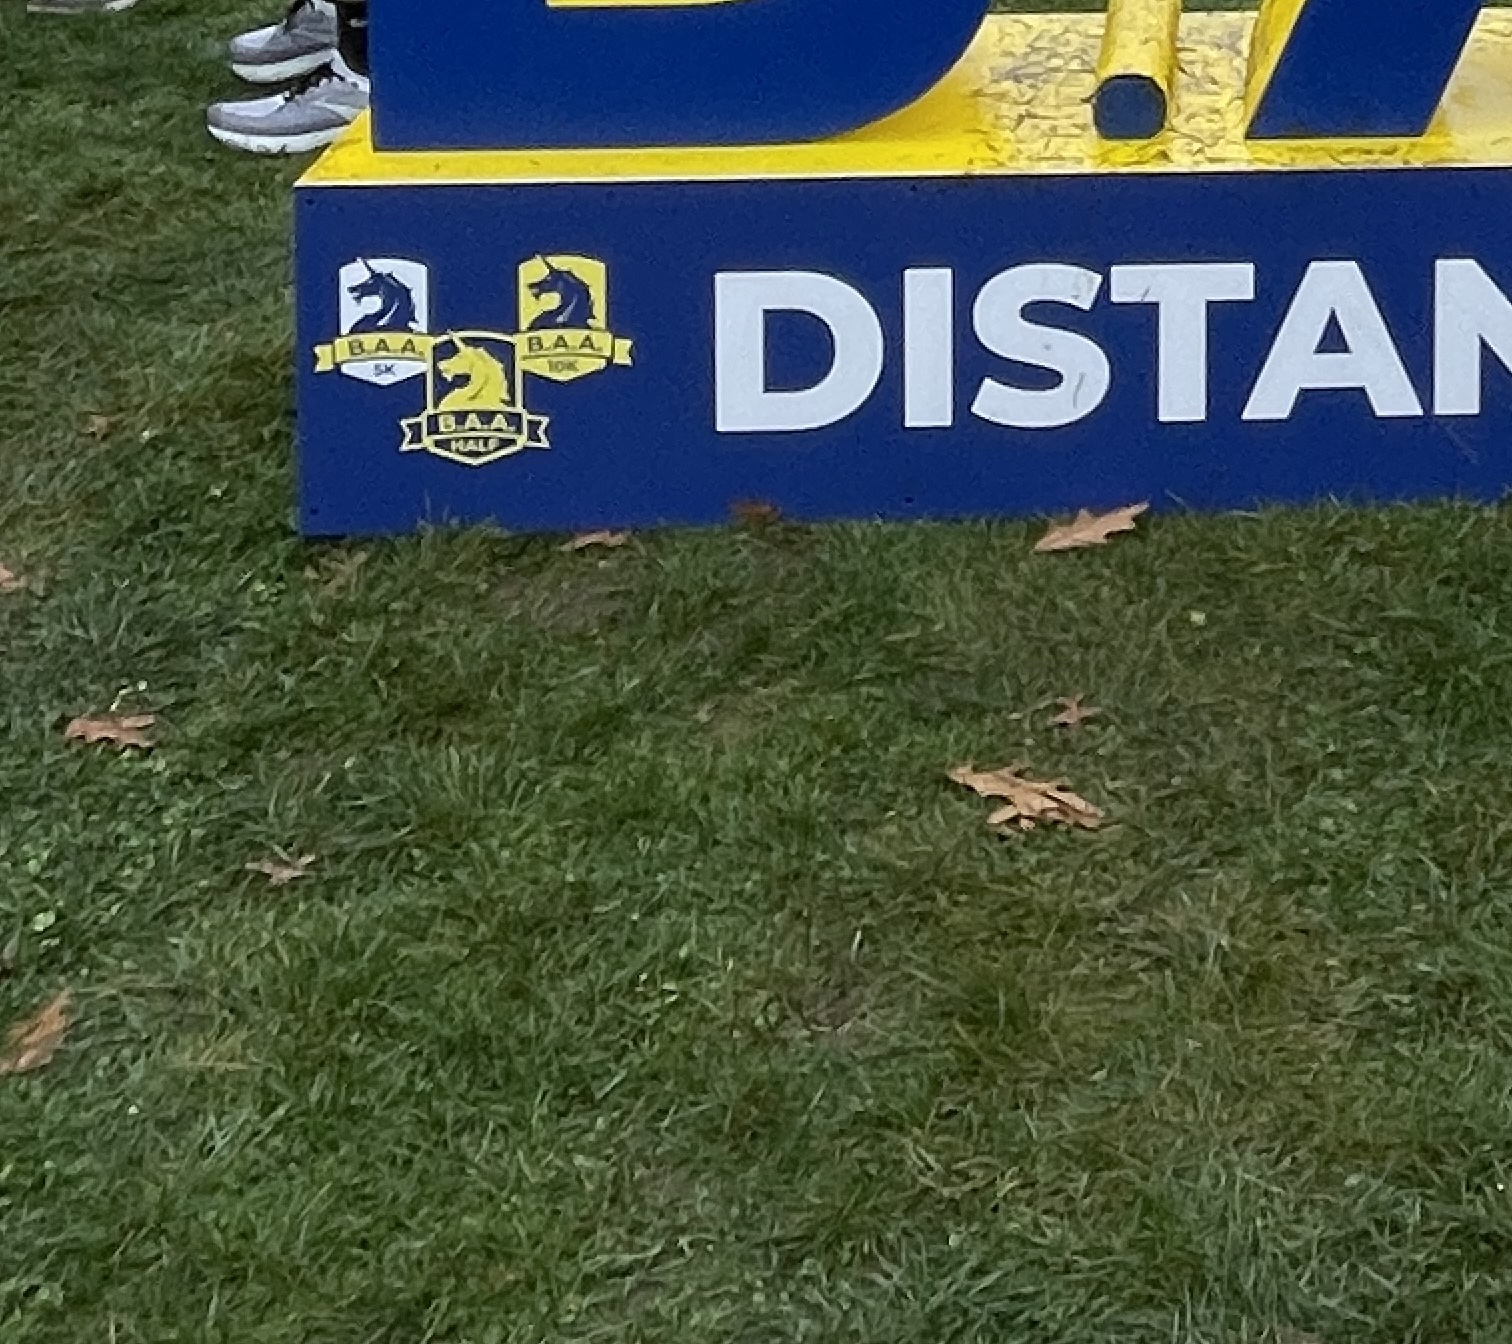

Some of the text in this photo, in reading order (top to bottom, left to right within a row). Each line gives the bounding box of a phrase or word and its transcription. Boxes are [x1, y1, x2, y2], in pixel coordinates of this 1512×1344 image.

[349, 338, 425, 357] B.A.A.
[527, 334, 604, 353] B.A.A.
[373, 363, 397, 377] 5K
